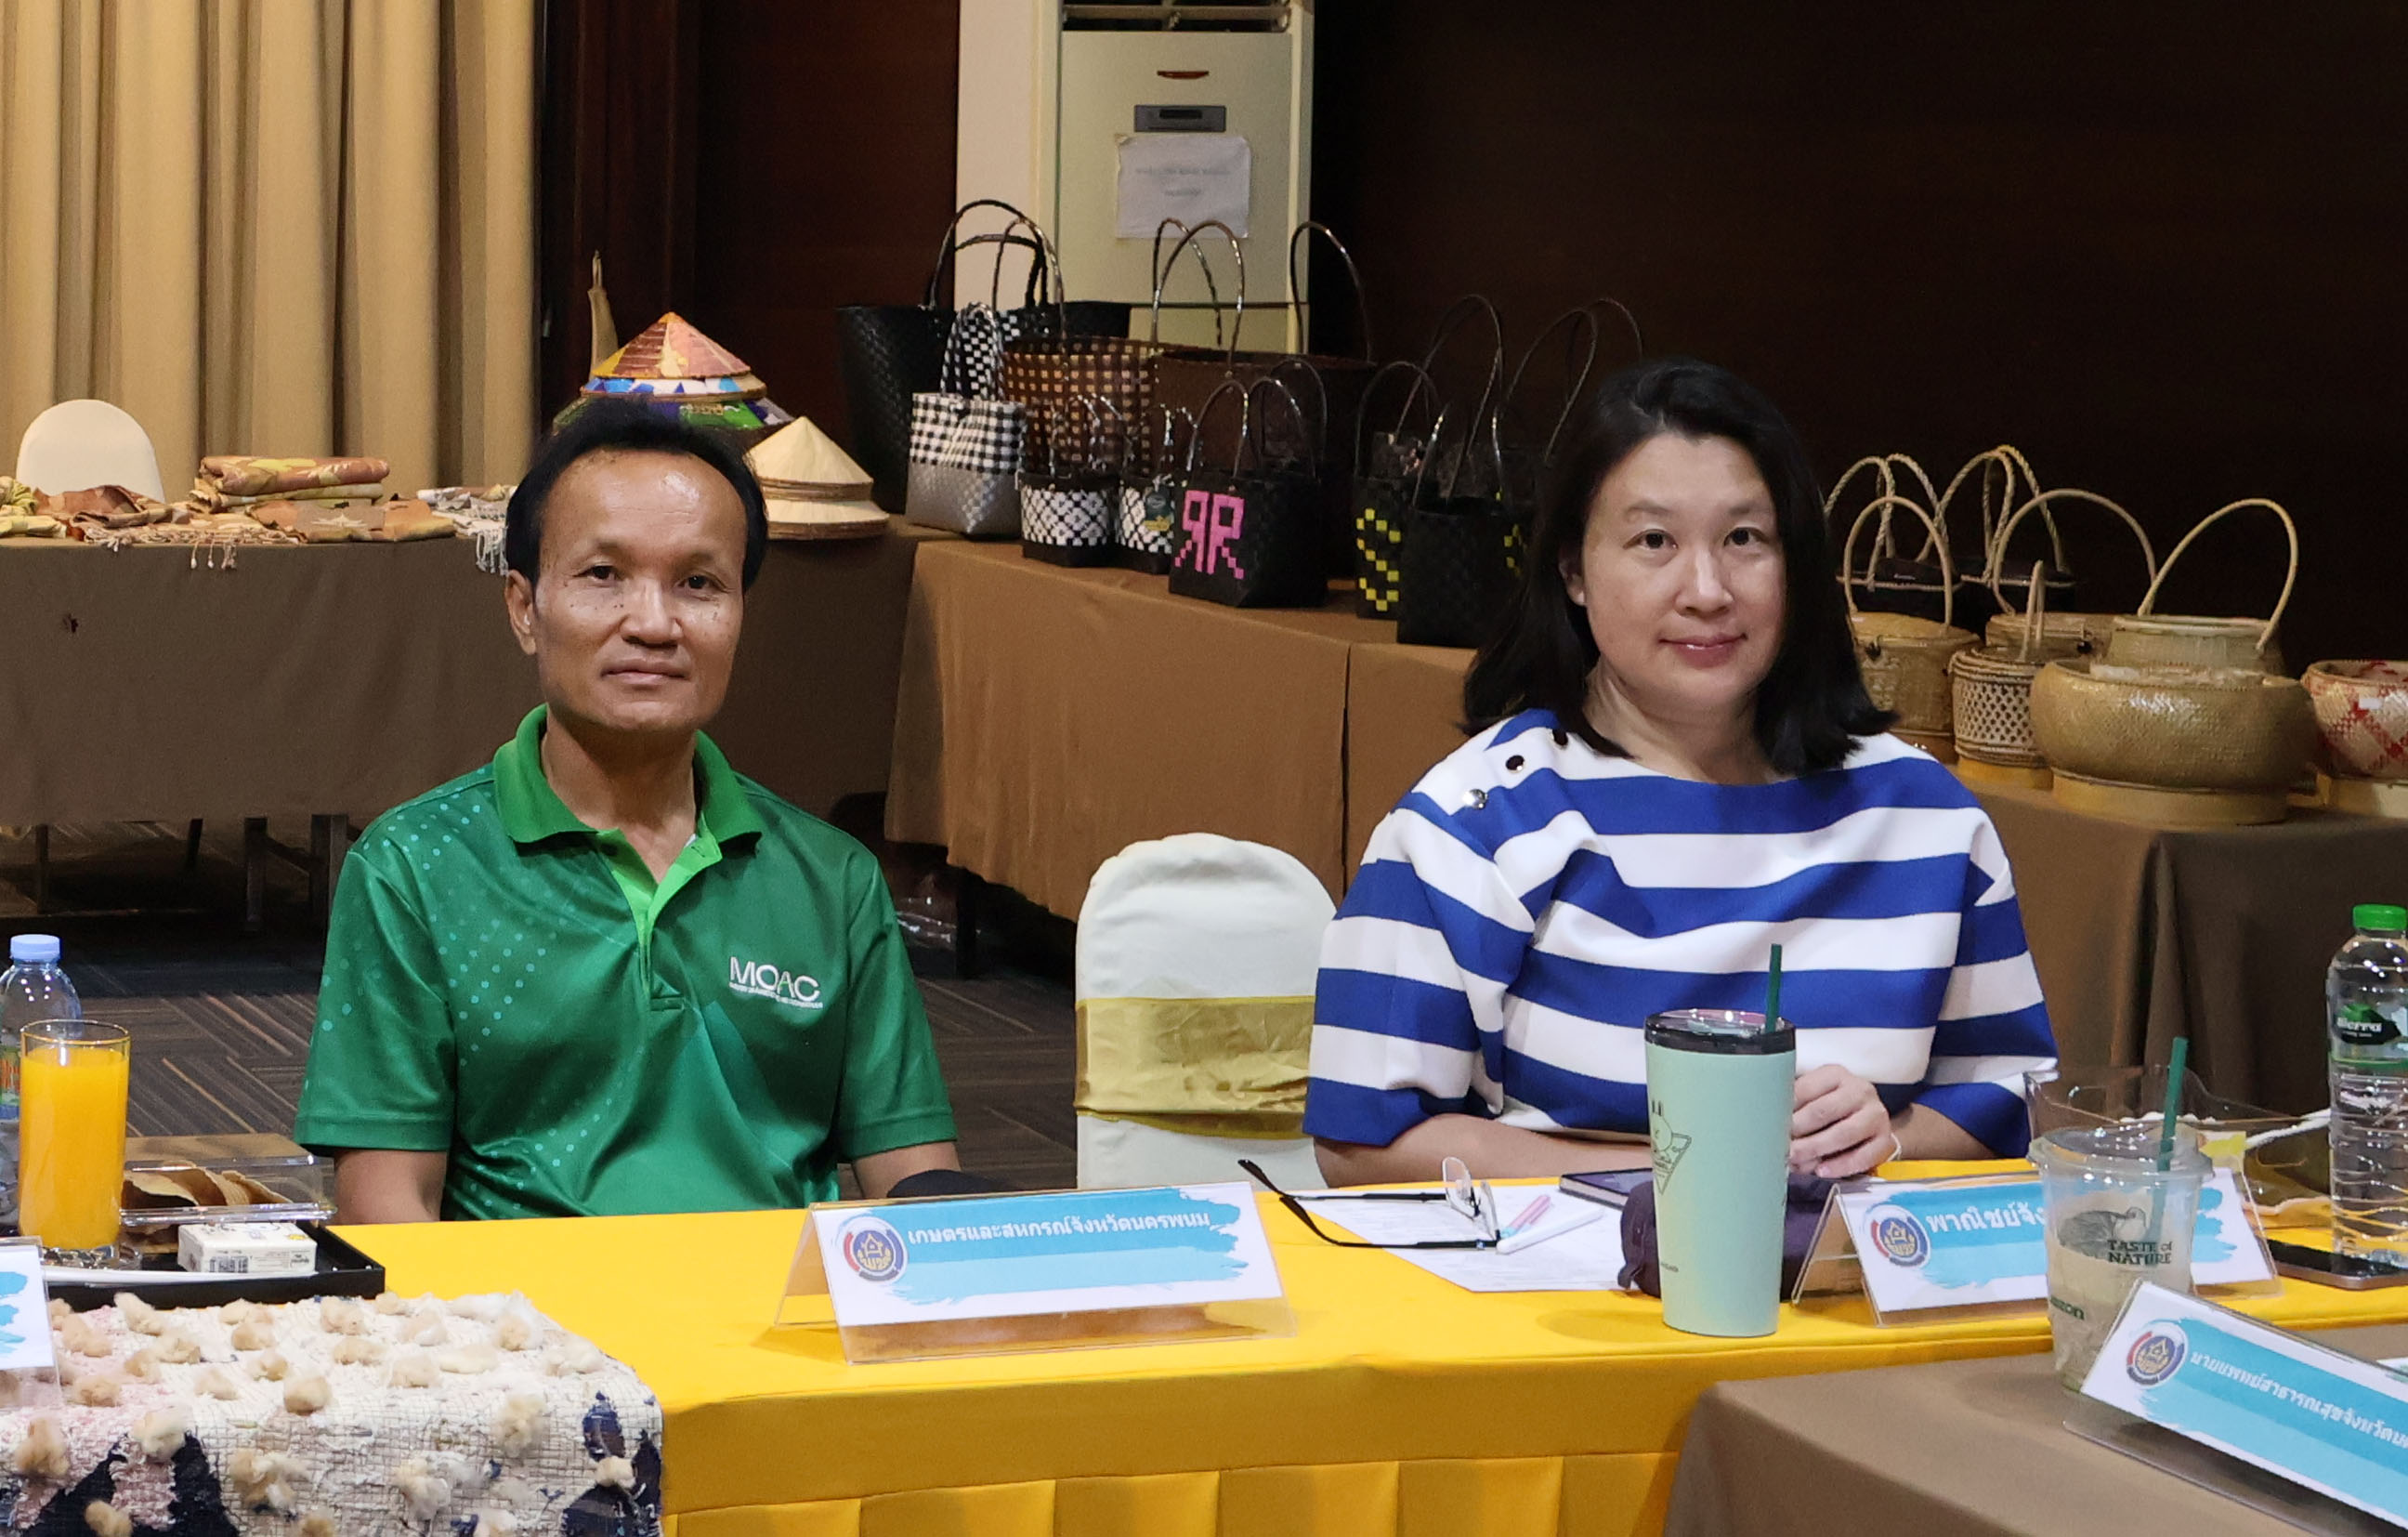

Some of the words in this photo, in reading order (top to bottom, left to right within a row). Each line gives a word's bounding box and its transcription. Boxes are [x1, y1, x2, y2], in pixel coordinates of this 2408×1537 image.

[730, 956, 820, 1002] MOAC
[1926, 1202, 2047, 1233] พาณิชย์จัง
[2107, 1240, 2156, 1252] TASTE
[2161, 1241, 2173, 1252] of
[2108, 1252, 2172, 1265] NATURE
